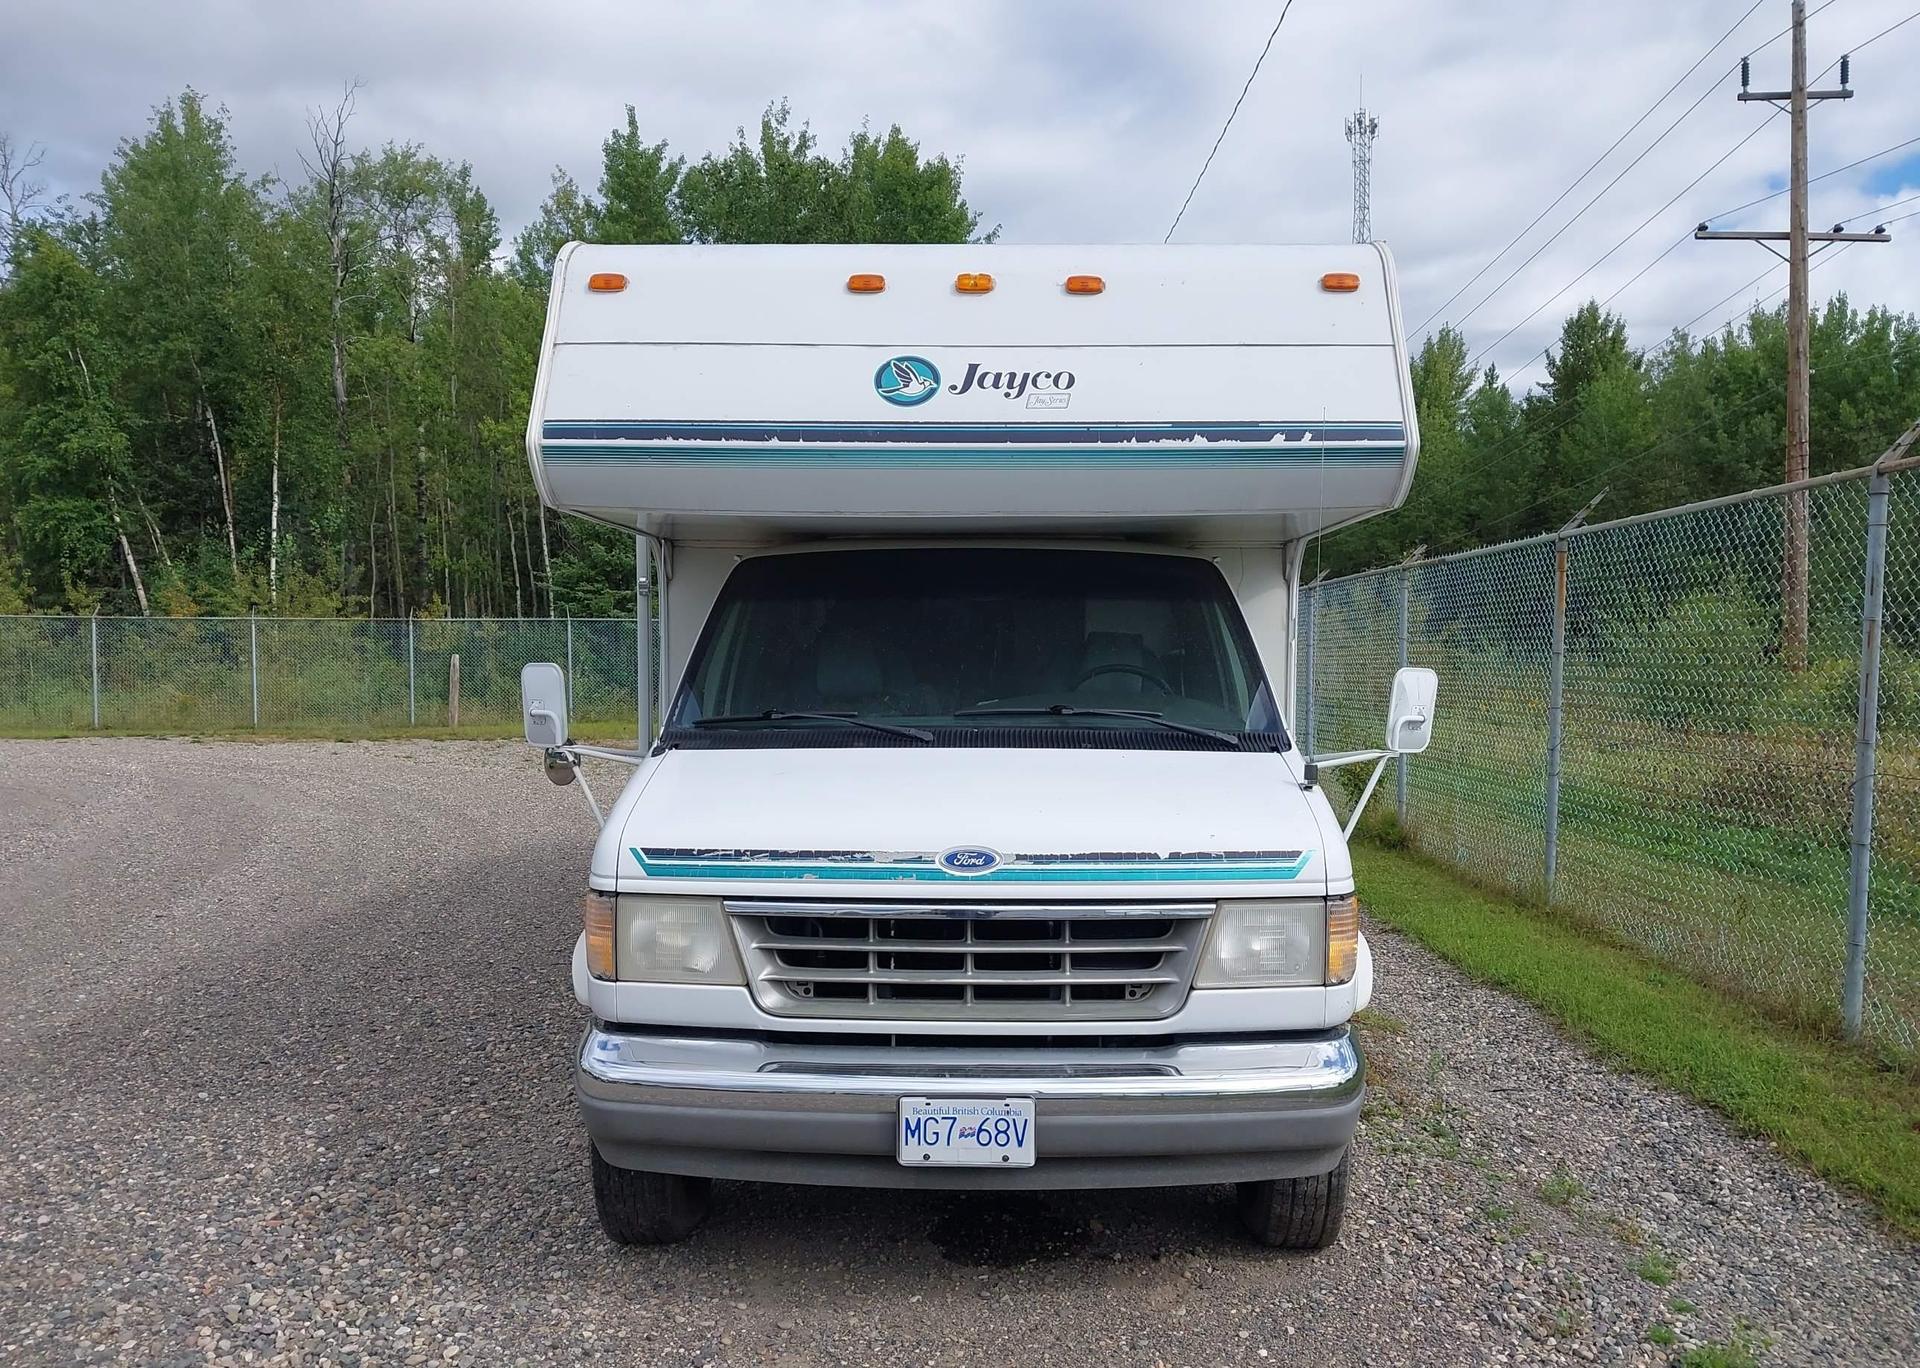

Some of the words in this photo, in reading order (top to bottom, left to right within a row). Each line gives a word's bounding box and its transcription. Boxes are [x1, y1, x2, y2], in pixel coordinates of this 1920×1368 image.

[948, 362, 1076, 399] Jayco
[953, 852, 985, 866] Ford
[912, 1106, 950, 1116] Beautiful
[952, 1107, 979, 1116] British
[980, 1107, 1022, 1117] Columbia
[904, 1116, 957, 1146] MG7
[976, 1117, 1028, 1148] 68V
